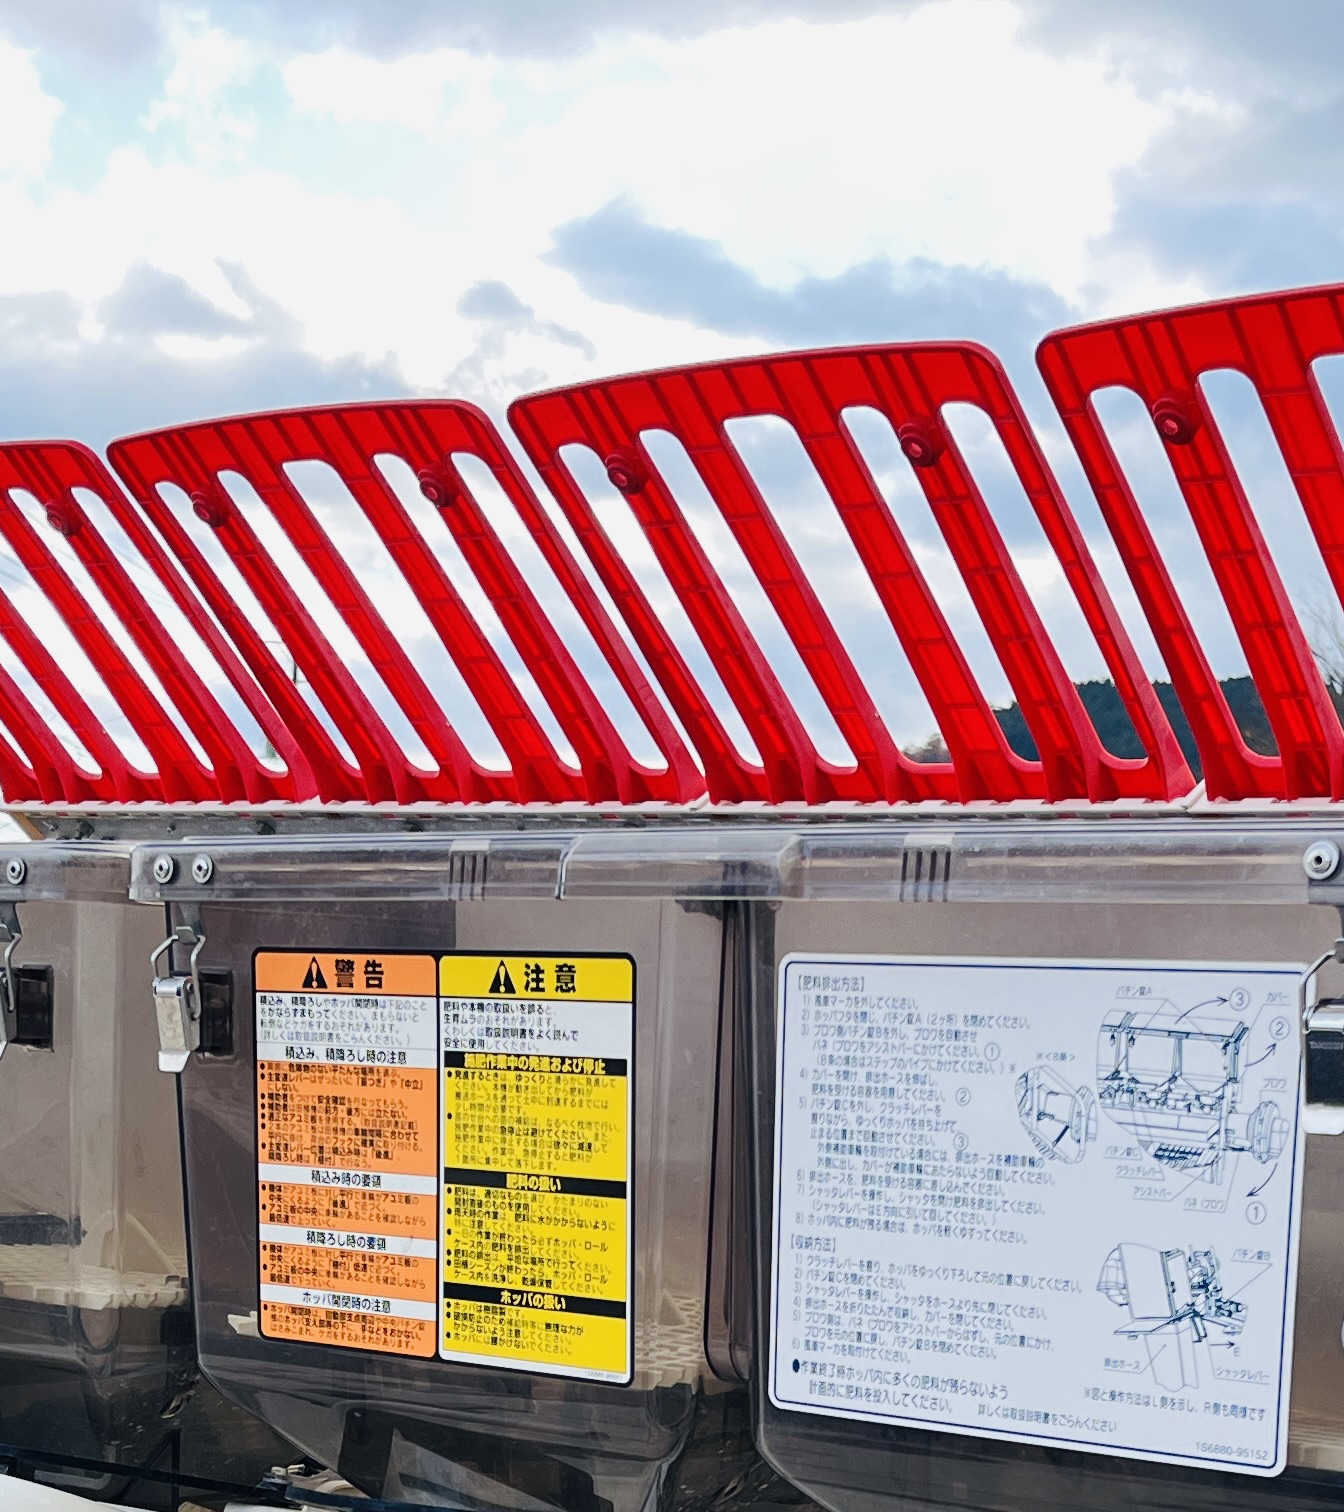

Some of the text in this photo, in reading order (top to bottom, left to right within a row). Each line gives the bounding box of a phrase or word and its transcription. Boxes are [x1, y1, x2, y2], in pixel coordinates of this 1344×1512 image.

[334, 958, 384, 989] 警告
[523, 962, 577, 994] 注意
[310, 1169, 382, 1188] 積込み時の要領
[306, 1229, 387, 1252] 積降ろし時の要領
[302, 1290, 391, 1314] ホッパ開閉時の注意
[500, 1289, 567, 1312] ホッパの扱い
